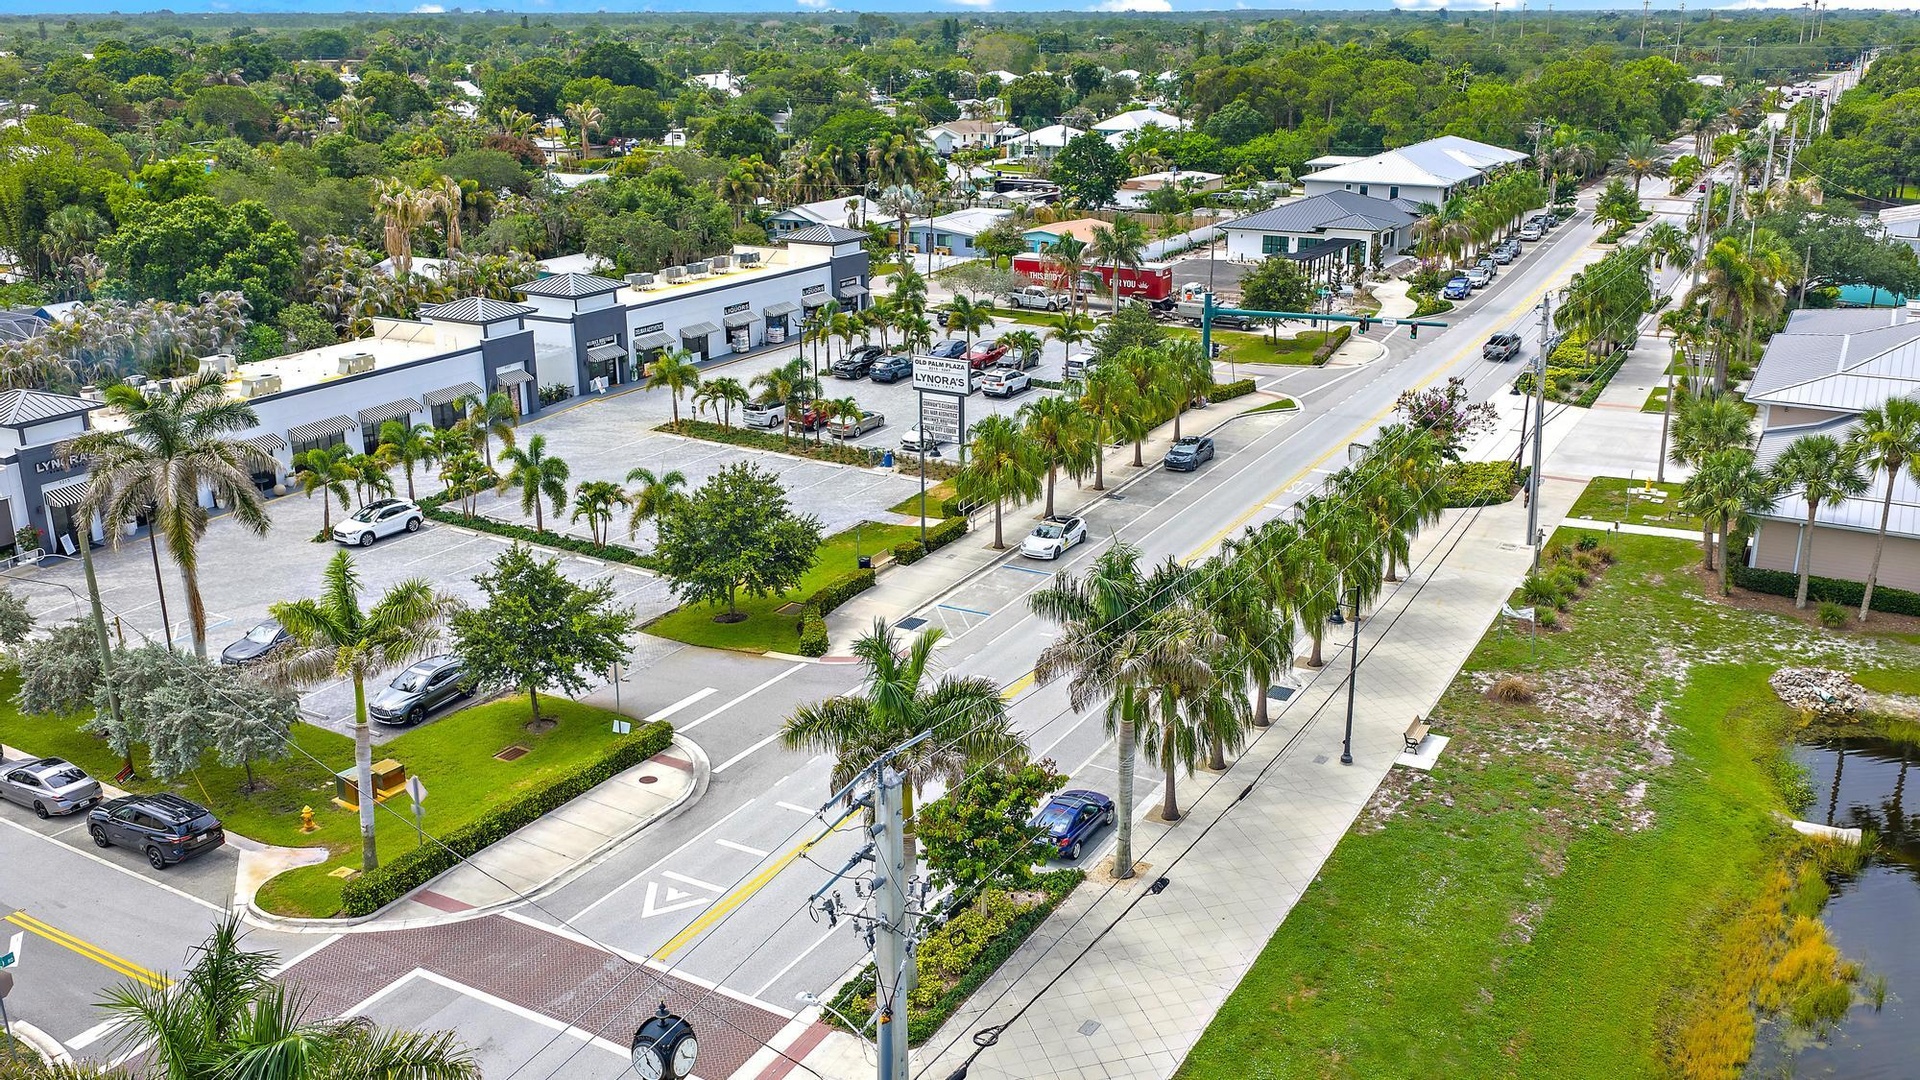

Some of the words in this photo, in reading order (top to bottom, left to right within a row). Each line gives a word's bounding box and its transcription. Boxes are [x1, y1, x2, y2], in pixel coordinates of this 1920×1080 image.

[1110, 279, 1122, 287] FR
[1123, 280, 1136, 288] YOU
[803, 286, 824, 296] LIQUORS
[724, 303, 749, 315] LIQUORS
[928, 360, 944, 368] PALM
[915, 373, 965, 387] LYNORA'S
